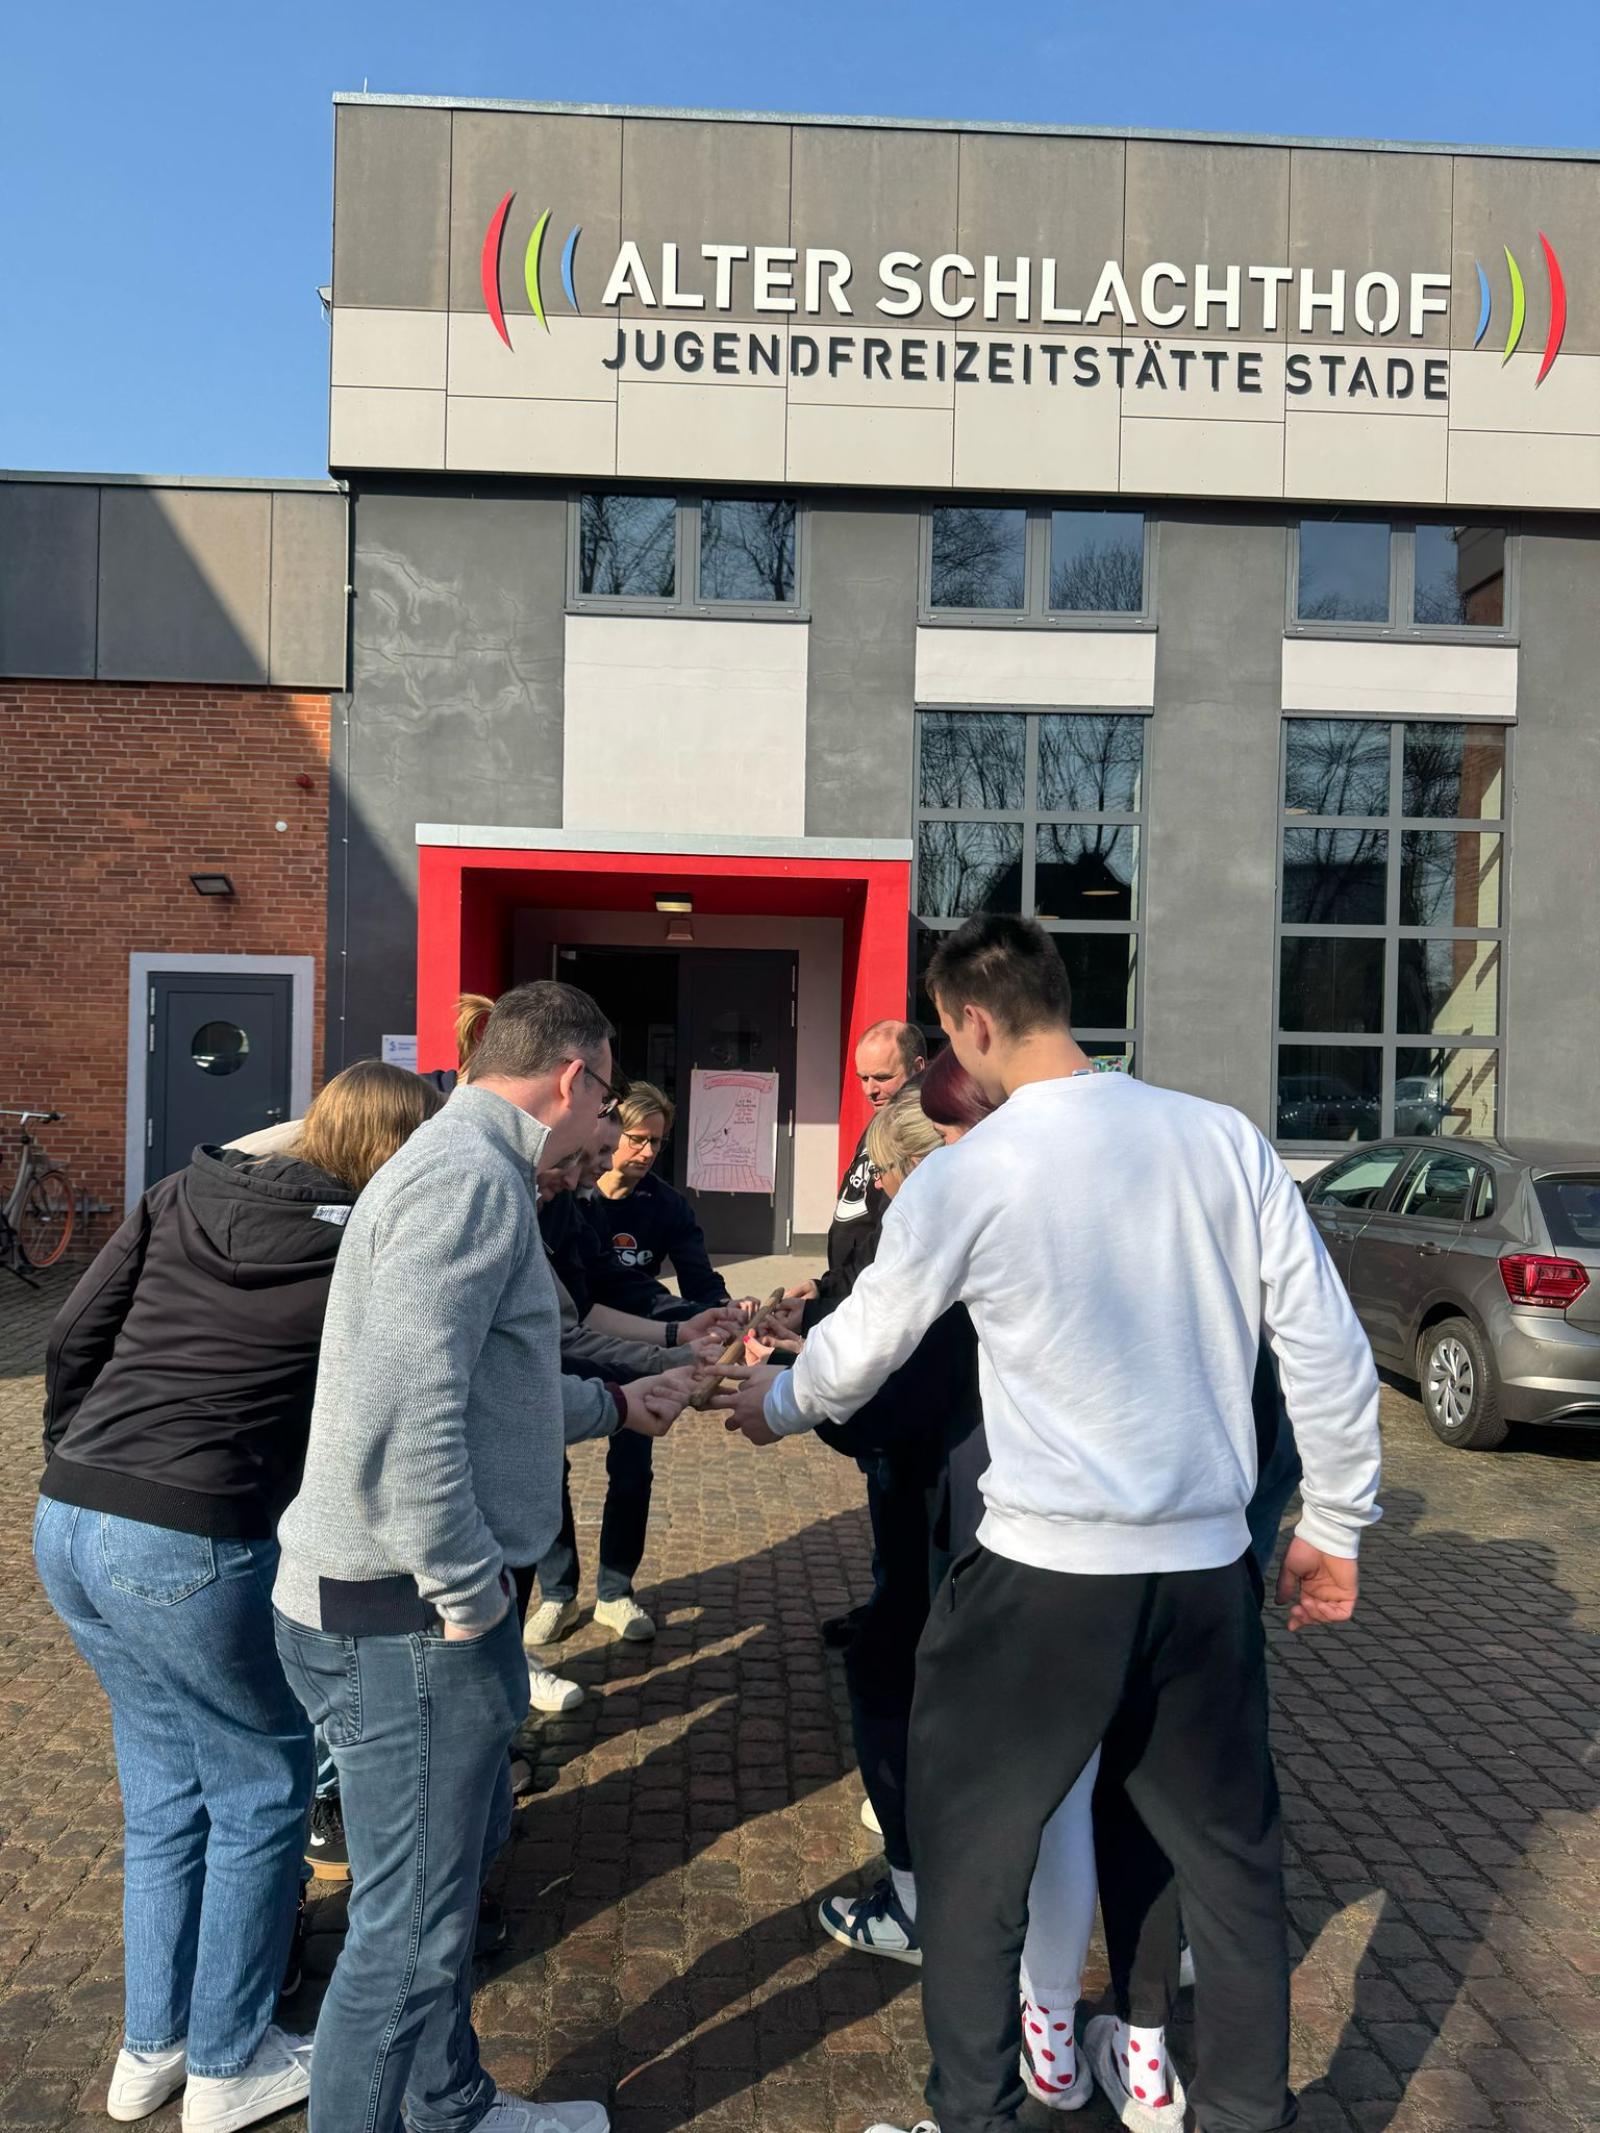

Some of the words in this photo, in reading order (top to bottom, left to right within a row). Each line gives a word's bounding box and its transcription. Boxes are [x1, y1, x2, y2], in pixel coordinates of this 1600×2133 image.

[601, 241, 853, 315] ALTER
[875, 251, 1451, 337] SCHLACHTHOF
[601, 328, 1262, 393] JUGENDFREIZEITSTÄTTE
[1285, 354, 1449, 399] STADE
